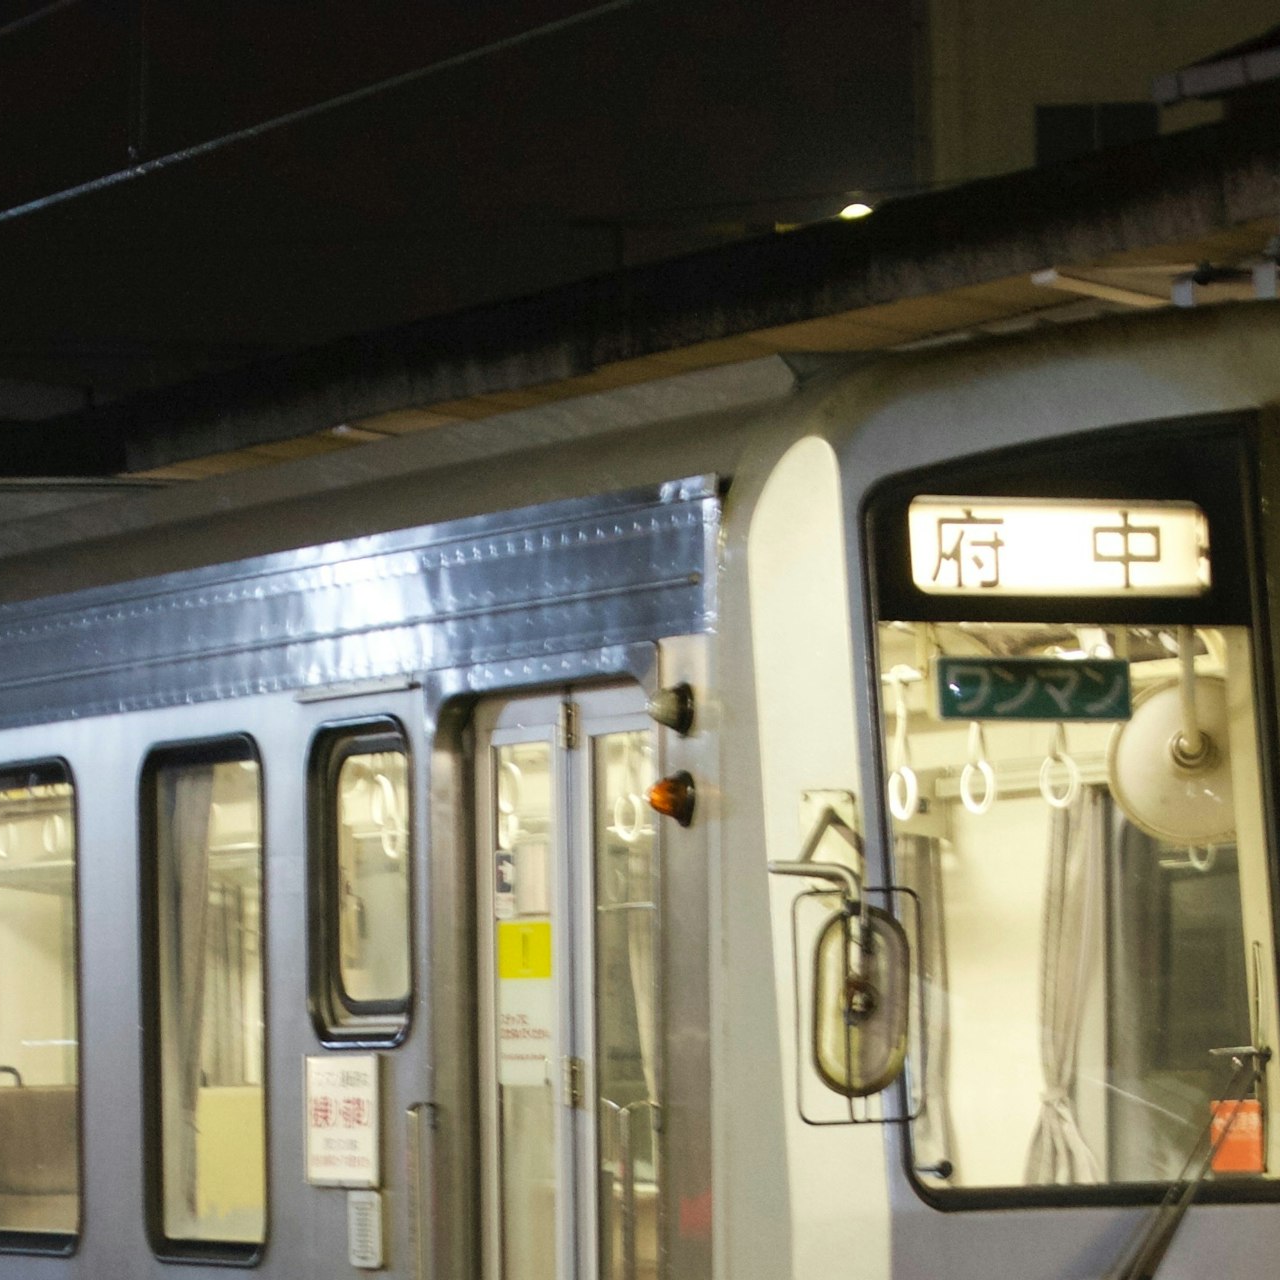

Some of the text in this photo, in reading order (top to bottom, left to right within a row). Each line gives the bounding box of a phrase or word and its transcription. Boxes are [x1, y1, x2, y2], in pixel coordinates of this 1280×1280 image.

[931, 509, 1162, 589] 府中
[945, 666, 1124, 714] ワンマン
